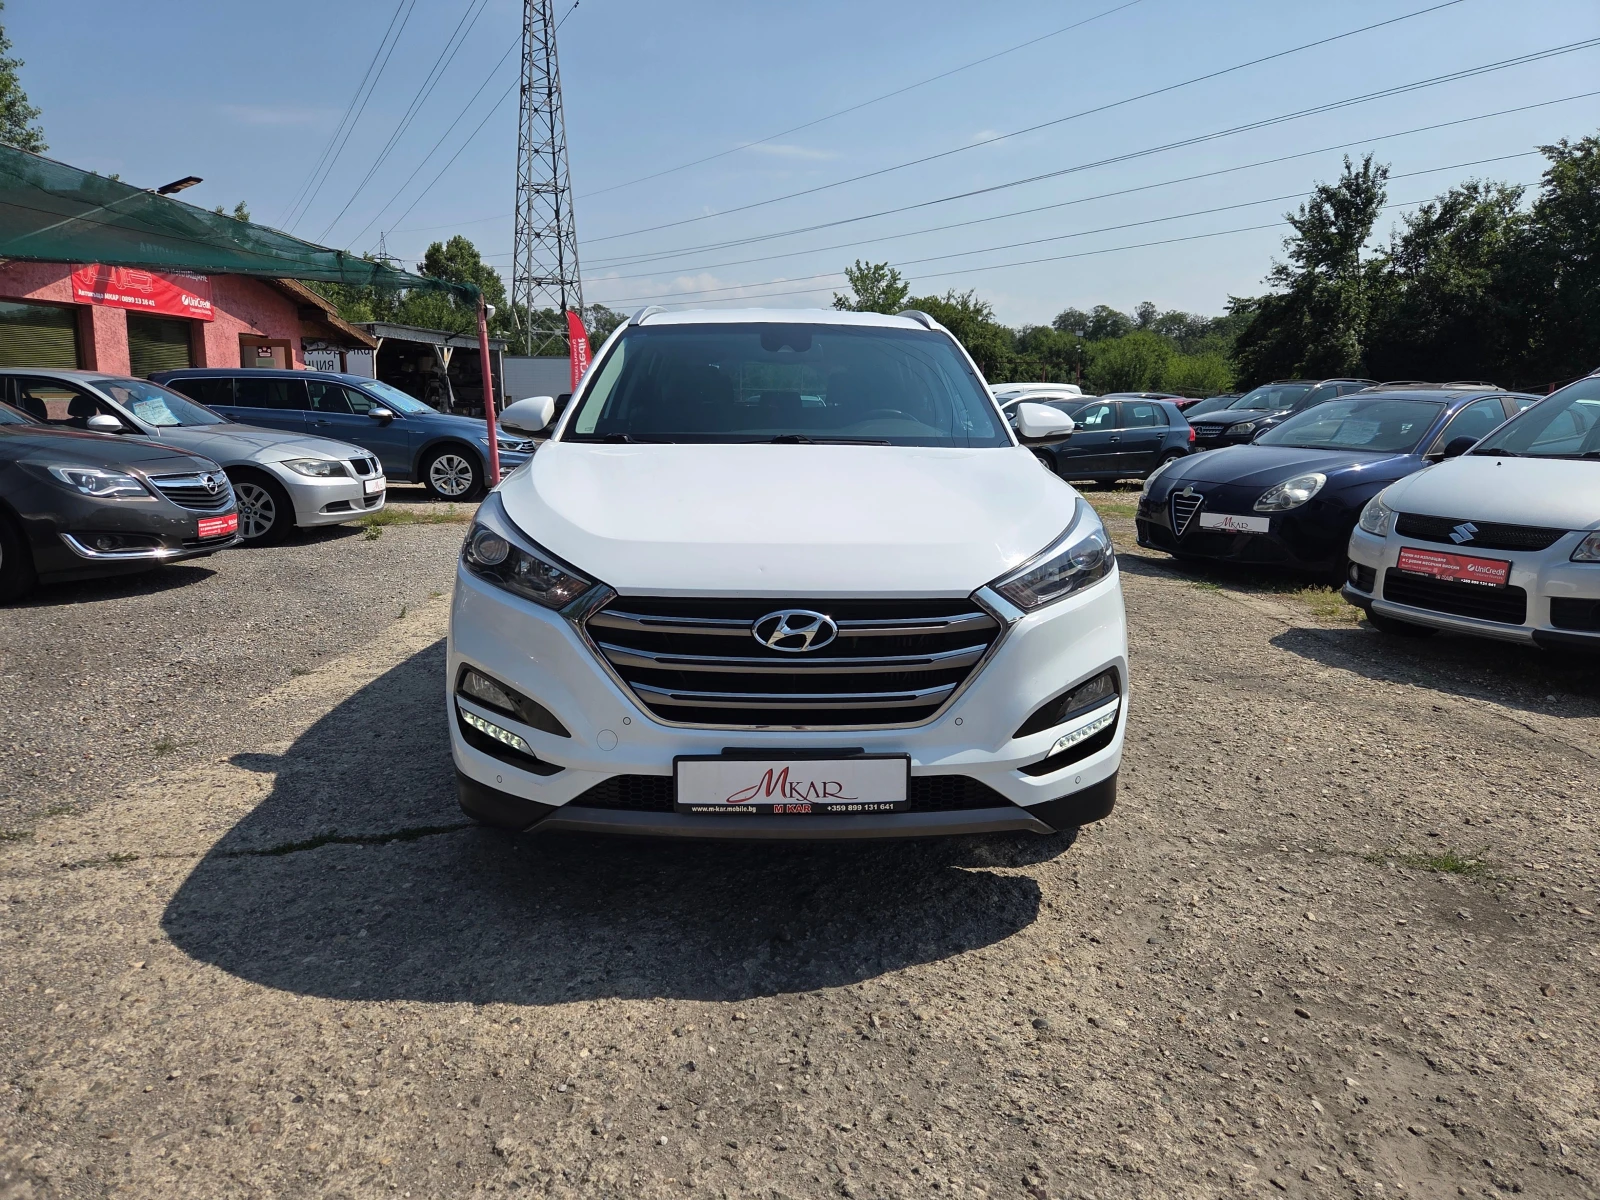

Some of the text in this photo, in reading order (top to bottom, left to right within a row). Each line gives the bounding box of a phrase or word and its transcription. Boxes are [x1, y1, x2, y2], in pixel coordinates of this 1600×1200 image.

[1475, 565, 1505, 576] UniCredit
[726, 766, 858, 803] MKAR
[691, 805, 757, 813] www.m-kar.mobile.bg
[773, 804, 811, 813] M KAR
